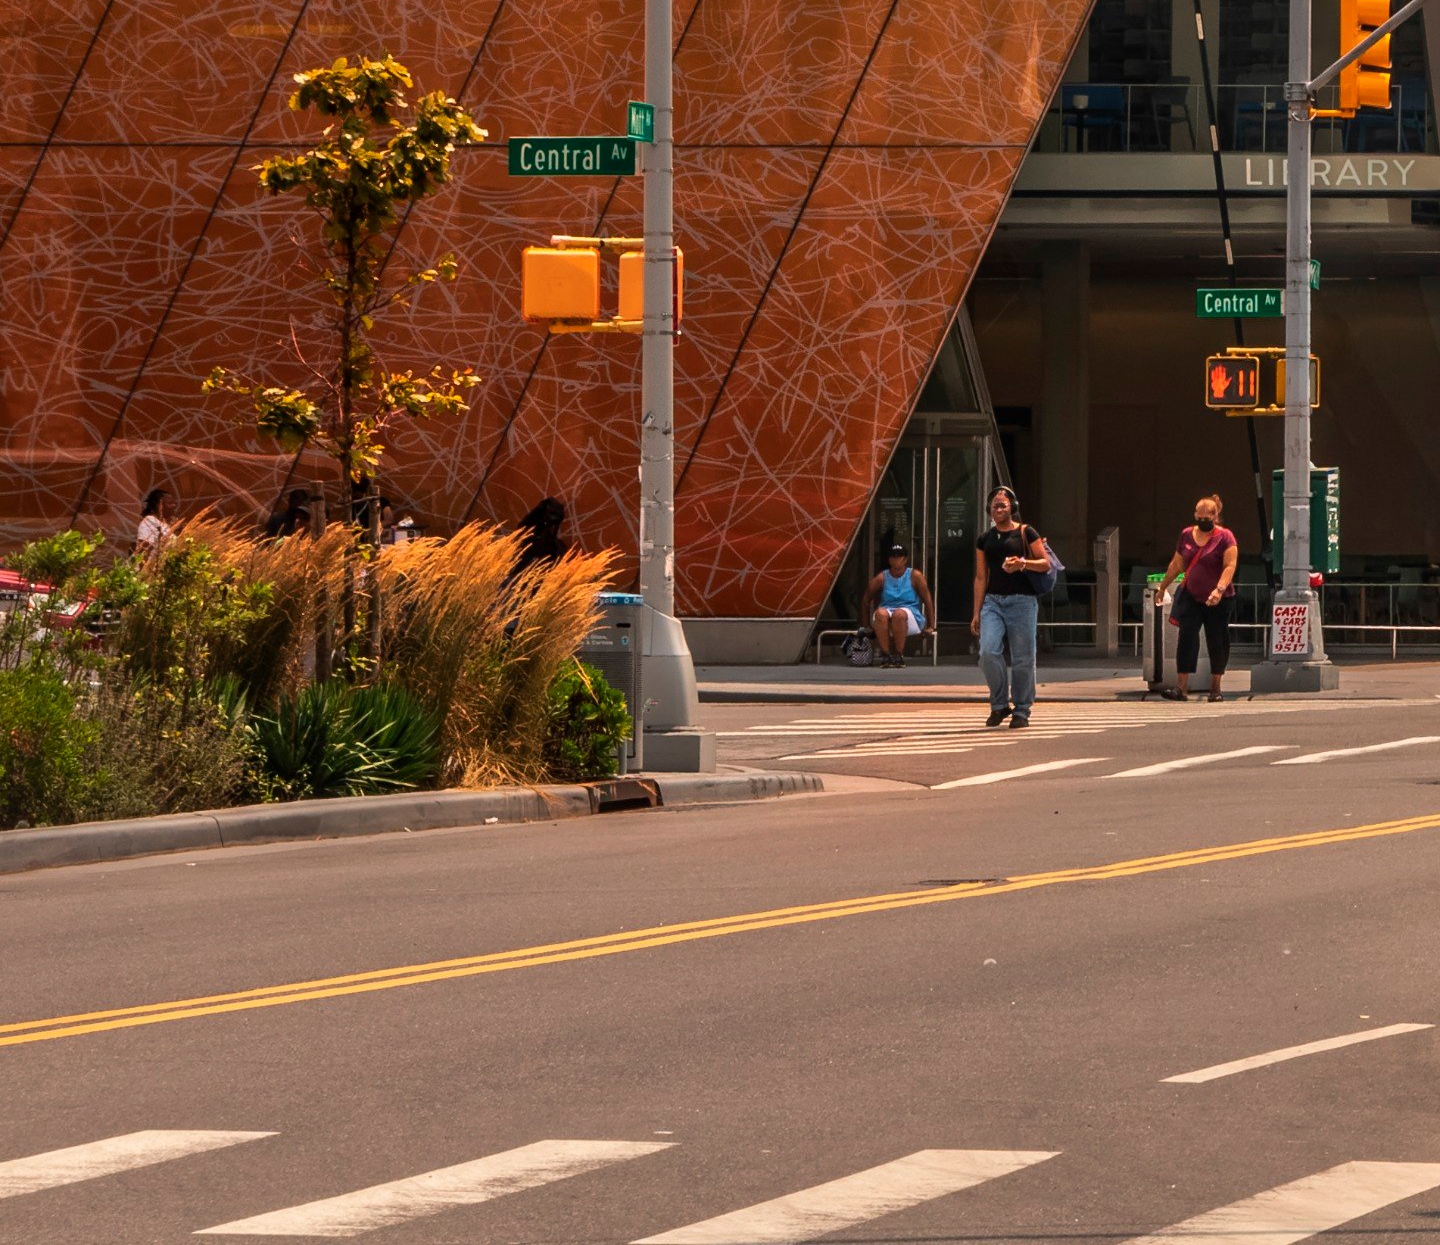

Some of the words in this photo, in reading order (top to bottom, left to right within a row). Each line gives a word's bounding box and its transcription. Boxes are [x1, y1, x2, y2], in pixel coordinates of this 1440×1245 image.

[520, 143, 600, 171] Central
[611, 143, 628, 160] Av
[1204, 293, 1259, 314] Central
[1265, 294, 1276, 306] Av
[1274, 617, 1281, 625] 4
[1279, 626, 1303, 635] 516
[1279, 635, 1302, 643] 341
[1275, 643, 1306, 652] 9517
